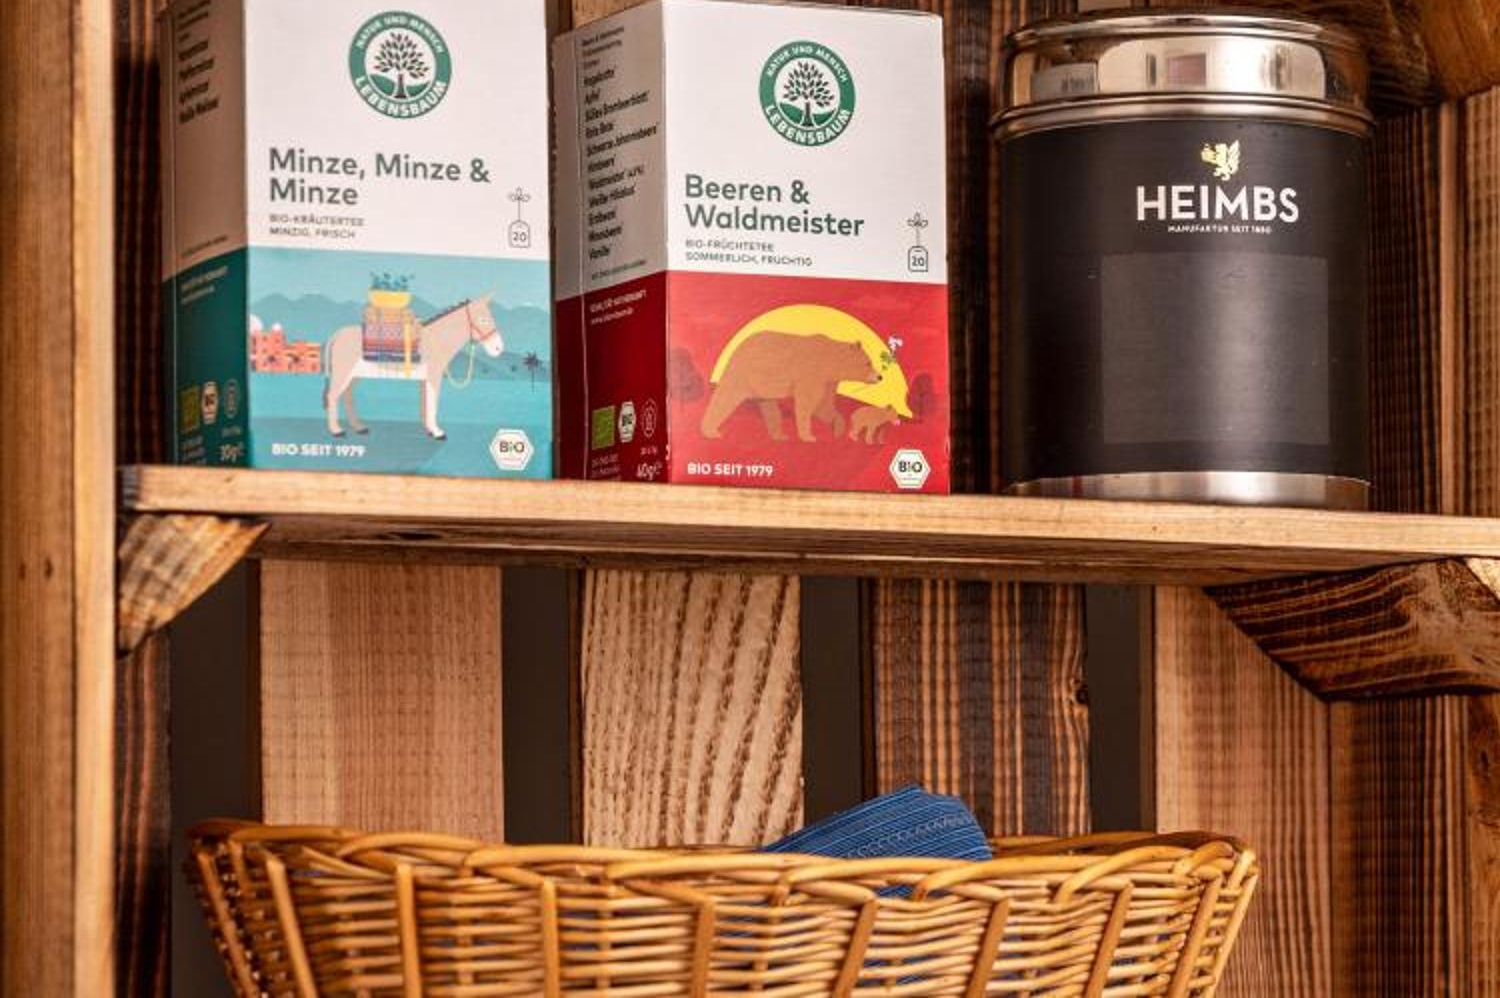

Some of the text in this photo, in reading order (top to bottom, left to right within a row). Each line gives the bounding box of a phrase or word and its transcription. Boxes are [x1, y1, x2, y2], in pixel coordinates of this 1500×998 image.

[383, 15, 408, 25] UND
[410, 19, 444, 53] MENSCH
[767, 45, 848, 83] NATUR UND MENSCH
[355, 76, 448, 118] LEBENSBAUM
[765, 105, 851, 145] LEBENSBAUM
[269, 148, 491, 183] Minze, Minze &
[269, 178, 359, 205] Minze
[685, 173, 811, 205] Beeren &
[1136, 185, 1300, 223] HEIMBS
[684, 204, 865, 237] Waldmeister
[1168, 224, 1229, 234] MANUFAKTUR
[1231, 225, 1248, 234] SEIT
[315, 228, 355, 239] FRISCH
[512, 231, 528, 244] 20
[685, 237, 775, 253] BIO-FRÜCHTETEE
[911, 256, 925, 268] 20
[271, 442, 366, 459] BIO SEIT 1979
[499, 441, 525, 453] BIO
[687, 462, 774, 477] BIO SEIT 1979
[898, 461, 923, 473] BIO
